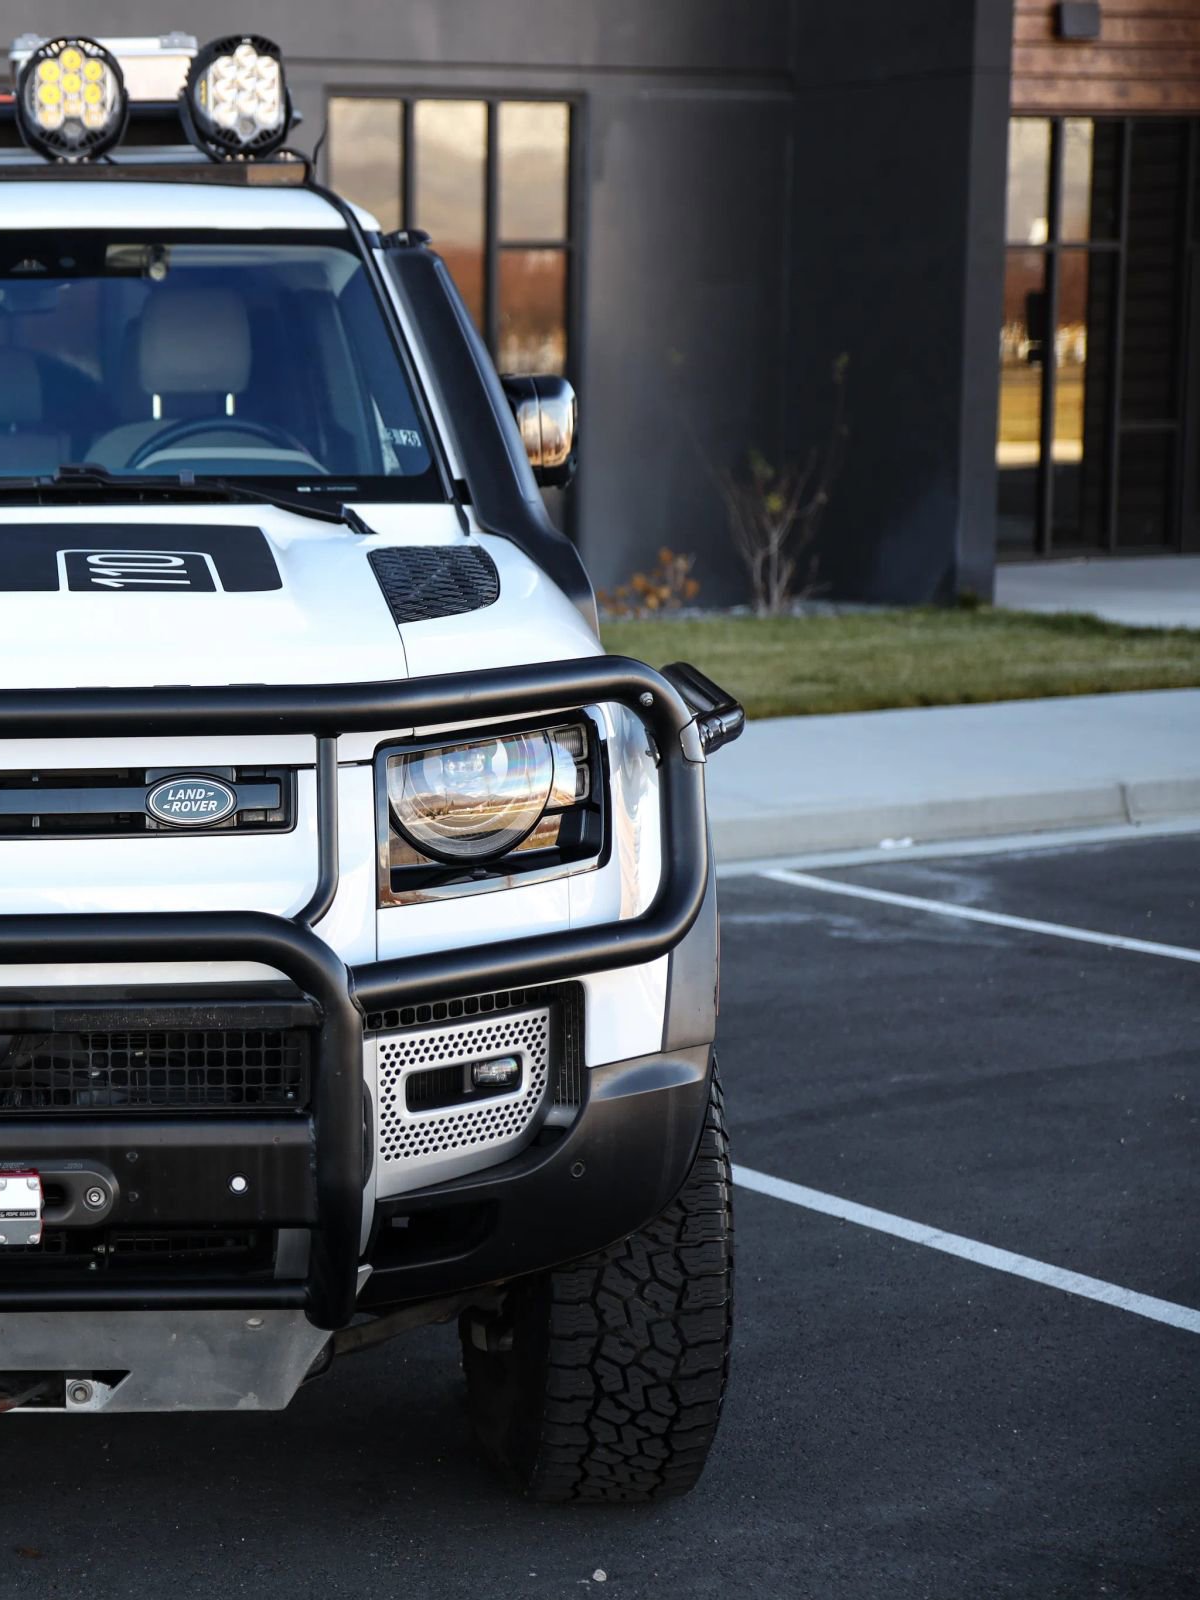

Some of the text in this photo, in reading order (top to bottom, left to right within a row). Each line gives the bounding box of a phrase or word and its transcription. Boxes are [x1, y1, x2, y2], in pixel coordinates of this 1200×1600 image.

[86, 554, 191, 588] 110
[167, 788, 206, 800] LAND
[171, 800, 218, 812] ROVER
